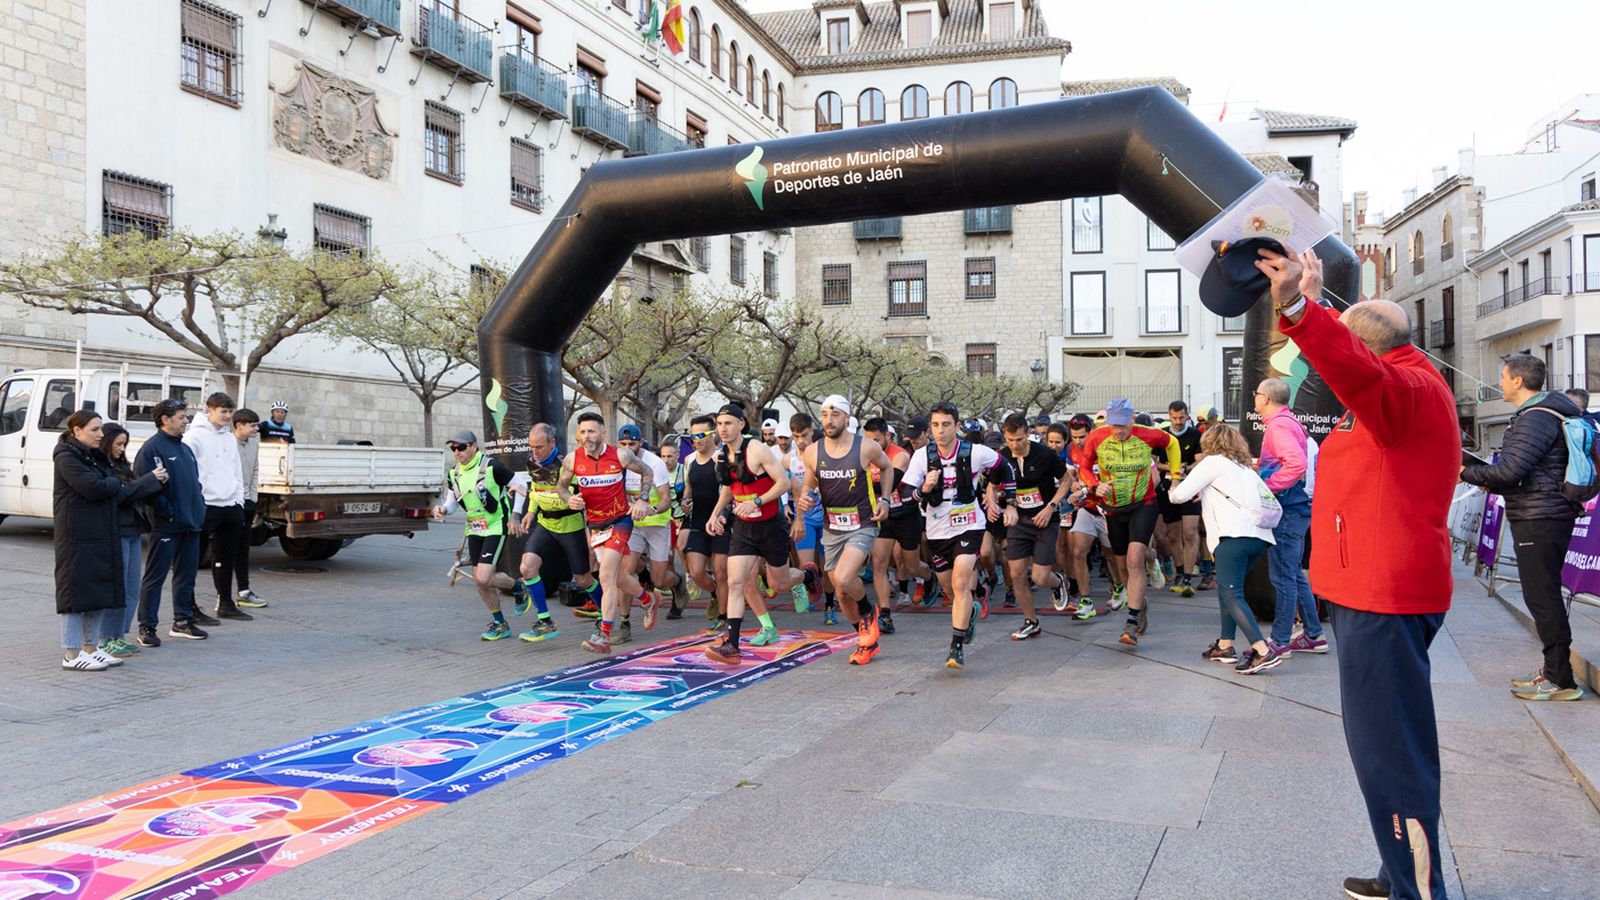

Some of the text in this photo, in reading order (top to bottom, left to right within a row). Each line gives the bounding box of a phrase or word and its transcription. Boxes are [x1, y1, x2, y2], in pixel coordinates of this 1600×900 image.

[773, 142, 944, 176] Patronato Municipal de
[774, 165, 904, 194] Deportes de Jaén
[1309, 424, 1332, 434] Jaén
[953, 515, 968, 523] 121
[320, 803, 419, 846] TEAMERGY
[161, 867, 257, 900] TEAME
